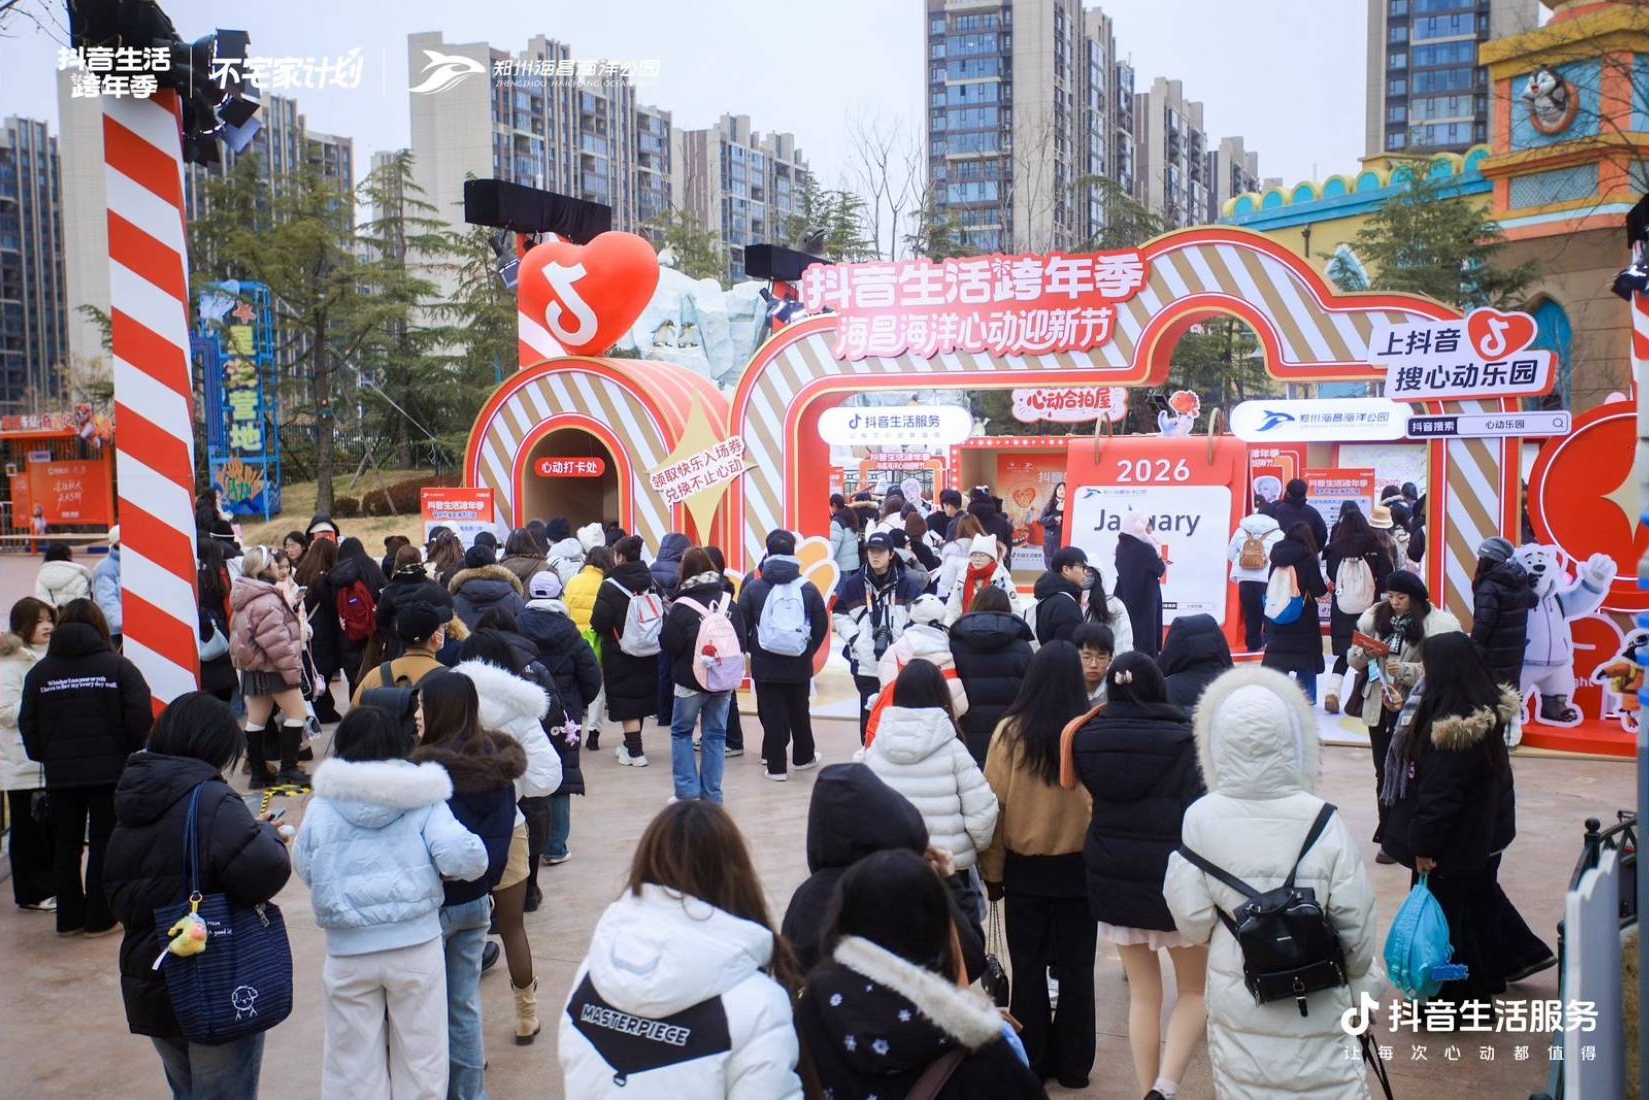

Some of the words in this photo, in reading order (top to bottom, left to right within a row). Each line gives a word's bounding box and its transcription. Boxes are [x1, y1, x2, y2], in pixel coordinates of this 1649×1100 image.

[803, 253, 1145, 309] 抖音生活跨年季
[840, 307, 1112, 352] 海昌海洋心动迎新节
[1377, 328, 1461, 356] 上抖音
[1395, 360, 1538, 392] 搜心动乐园
[1026, 387, 1112, 410] 心动合拍屋
[865, 415, 940, 429] 抖音生活服务
[1411, 420, 1455, 433] 抖音搜索
[1485, 420, 1525, 429] 心动乐园
[541, 461, 598, 474] 心动打卡处
[651, 438, 742, 488] 领取快乐入场券
[1116, 459, 1191, 483] 2026
[665, 460, 743, 502] 兑换不止心动
[1095, 508, 1201, 536] Jaary
[581, 1004, 692, 1046] MASTERPIECE
